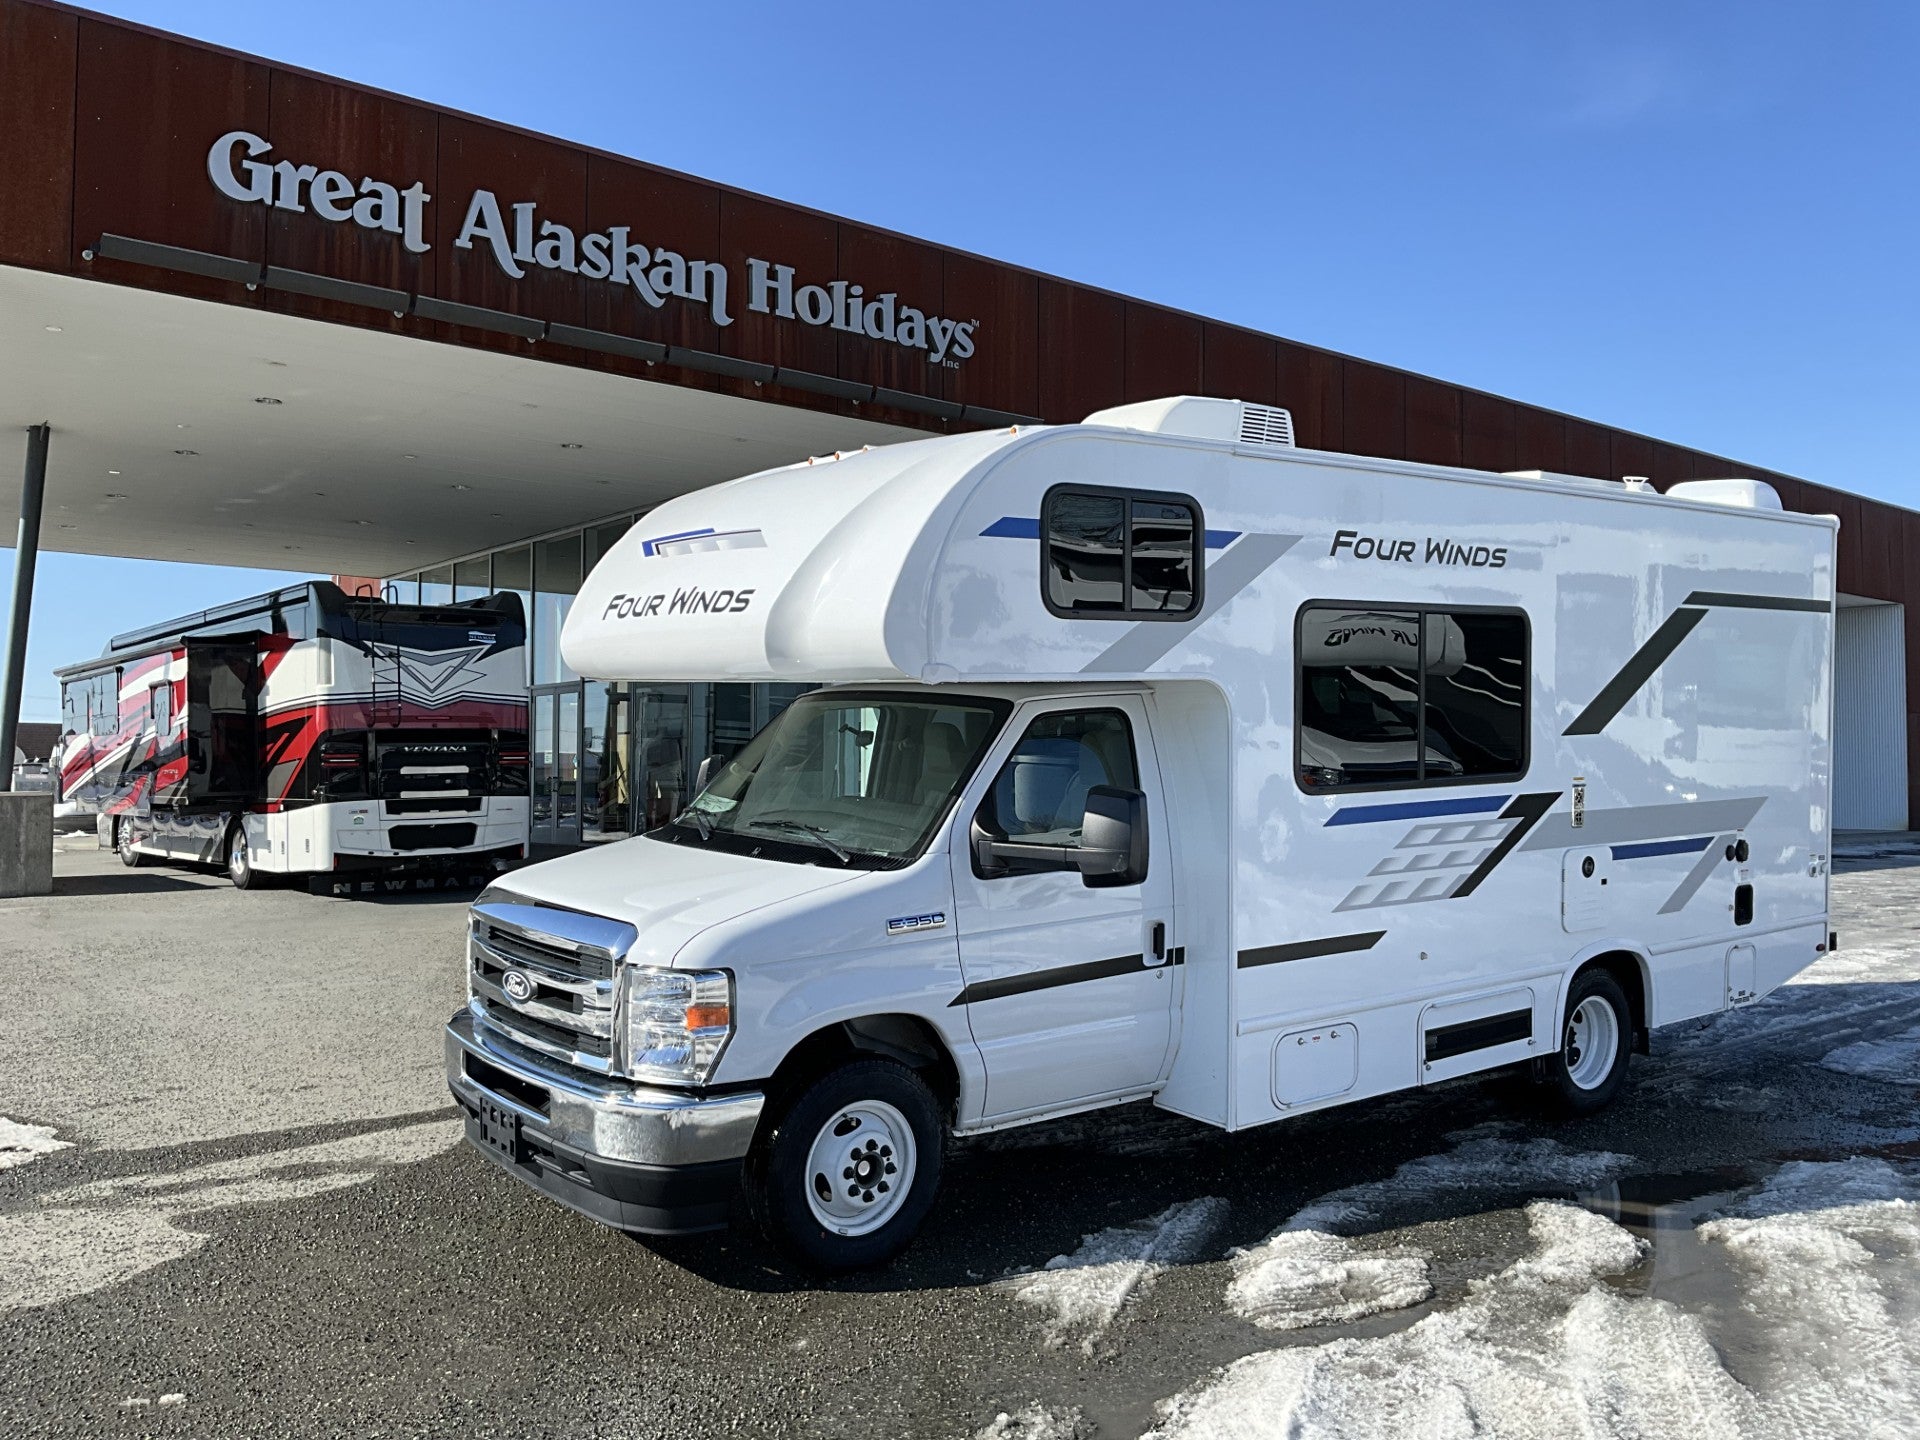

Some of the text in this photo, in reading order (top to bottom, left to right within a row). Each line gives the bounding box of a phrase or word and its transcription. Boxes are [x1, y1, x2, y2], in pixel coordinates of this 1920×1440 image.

[207, 131, 431, 254] Great
[455, 190, 734, 326] Alaskan
[746, 257, 974, 363] Holidays
[942, 357, 960, 369] Inc
[1329, 530, 1507, 568] FOUR WINDS
[602, 586, 756, 621] FOUR WINDS
[333, 875, 485, 894] NEWMAR
